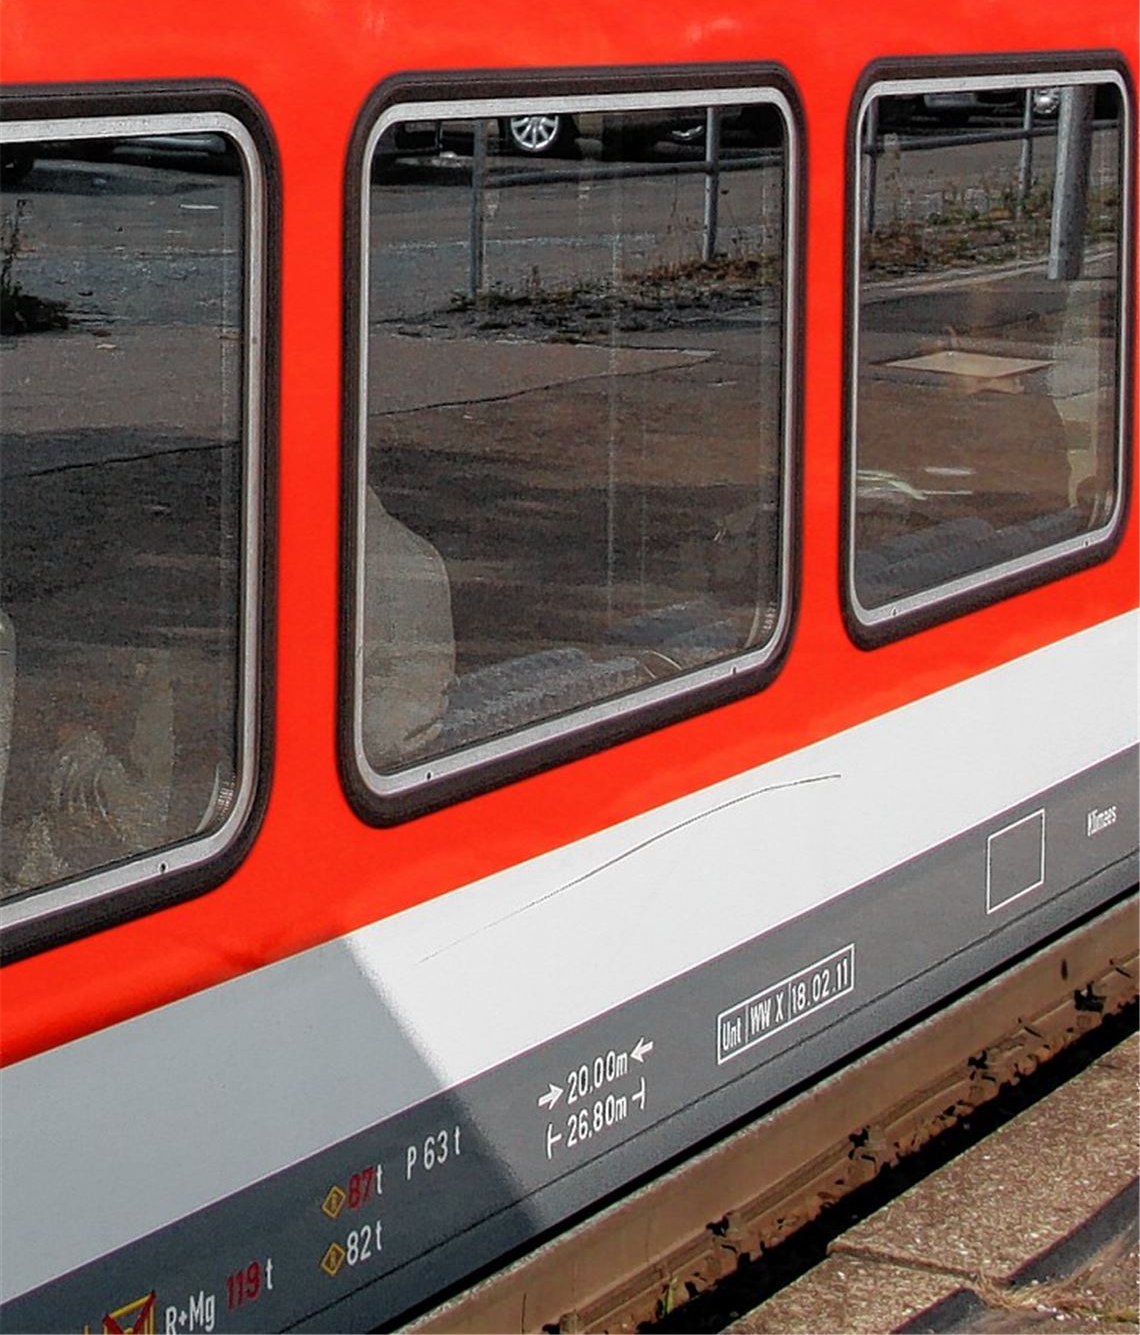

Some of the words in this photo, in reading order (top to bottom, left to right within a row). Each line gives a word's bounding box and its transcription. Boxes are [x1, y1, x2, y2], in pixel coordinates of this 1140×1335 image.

[722, 1017, 741, 1050] Unt
[792, 958, 848, 1014] 18.02.11
[165, 1290, 215, 1335] R+Mg
